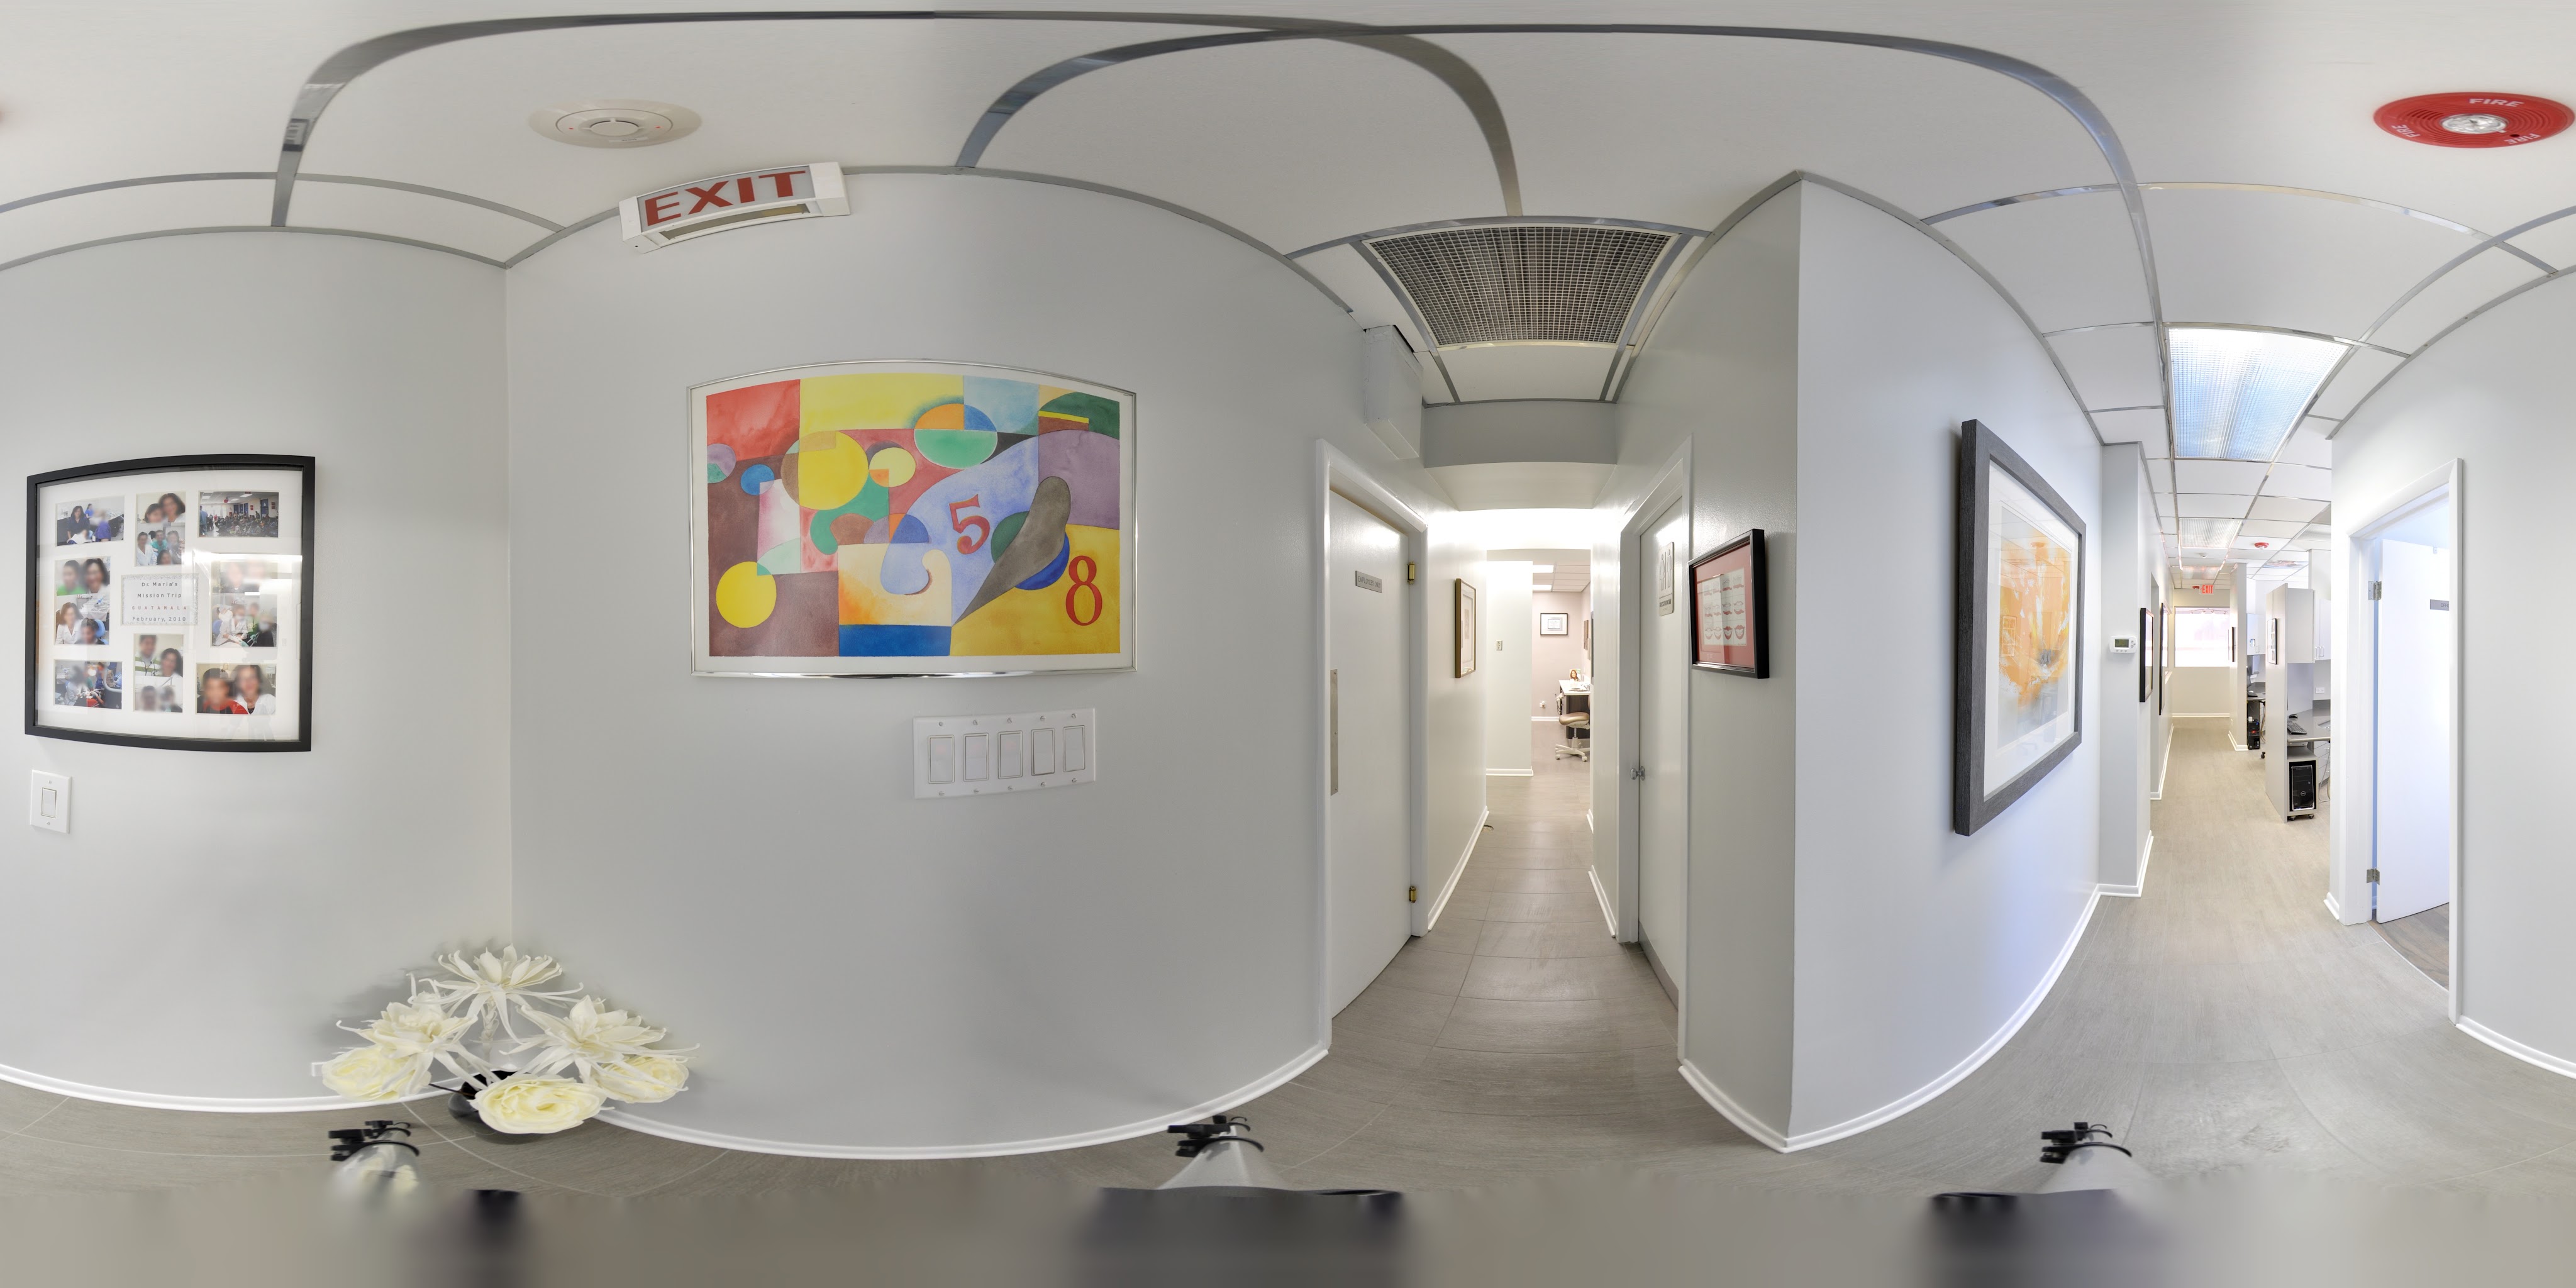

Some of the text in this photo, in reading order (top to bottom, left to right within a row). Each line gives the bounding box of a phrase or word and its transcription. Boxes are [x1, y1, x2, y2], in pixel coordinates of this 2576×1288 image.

[2469, 98, 2524, 108] FIRE
[2392, 124, 2421, 138] FIRE
[2504, 133, 2541, 145] FIRE
[645, 170, 806, 226] EXIT
[948, 494, 991, 555] 5
[1065, 555, 1102, 626] 8
[2202, 585, 2213, 594] EXIT
